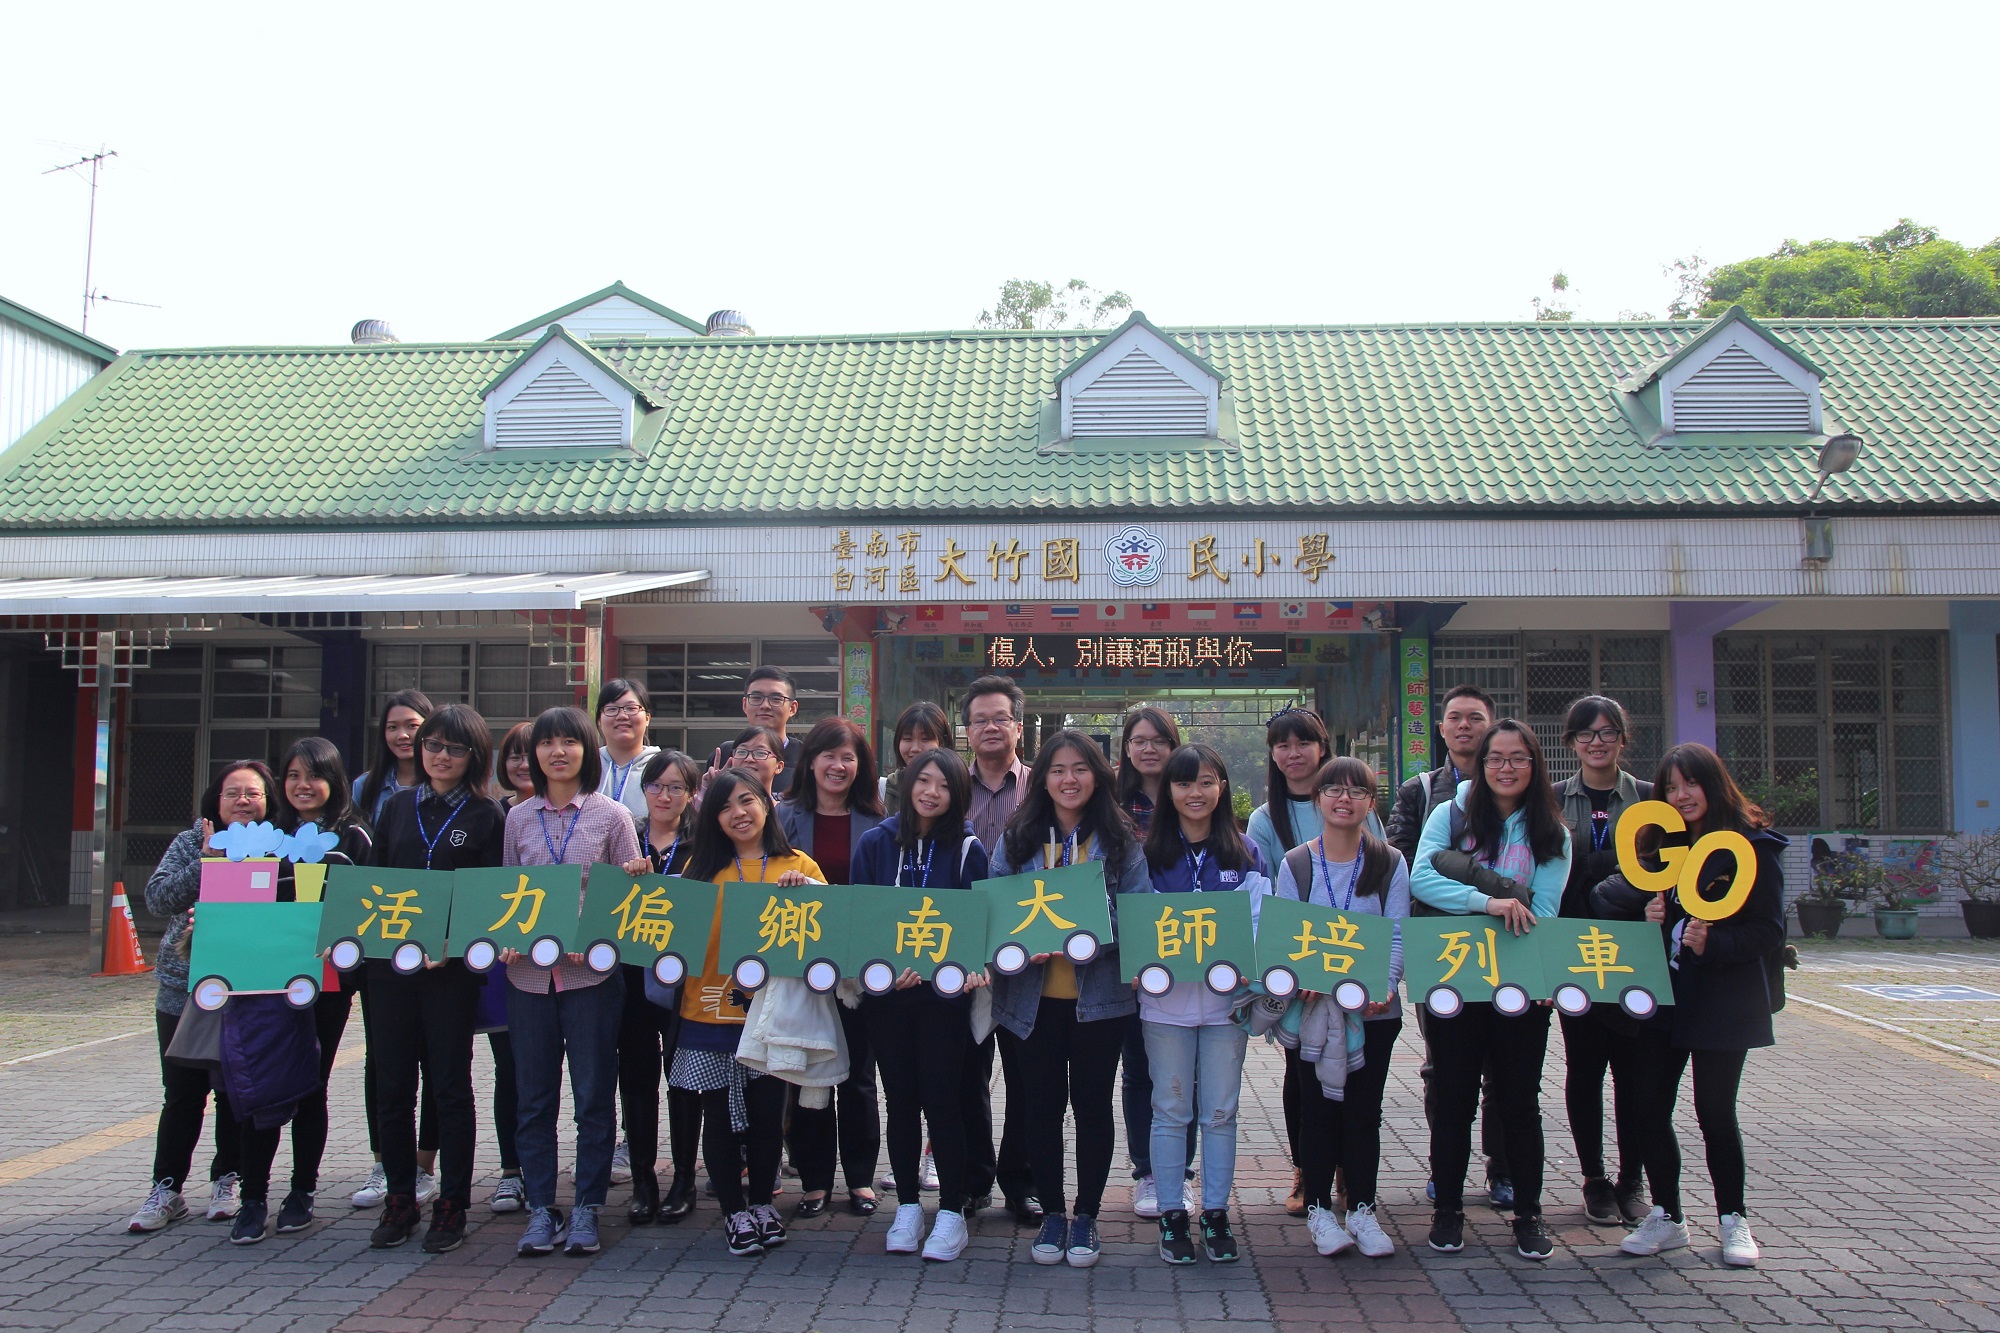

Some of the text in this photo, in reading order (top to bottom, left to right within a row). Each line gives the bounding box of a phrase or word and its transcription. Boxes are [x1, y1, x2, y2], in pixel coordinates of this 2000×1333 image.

[832, 528, 921, 560] 臺南市
[832, 564, 921, 592] 白河區
[934, 531, 1336, 585] 大竹國 民小學
[1406, 644, 1427, 774] 大展師藝造英才
[1615, 800, 1757, 921] GO
[357, 873, 1634, 991] 活力偏鄉南大師培列車
